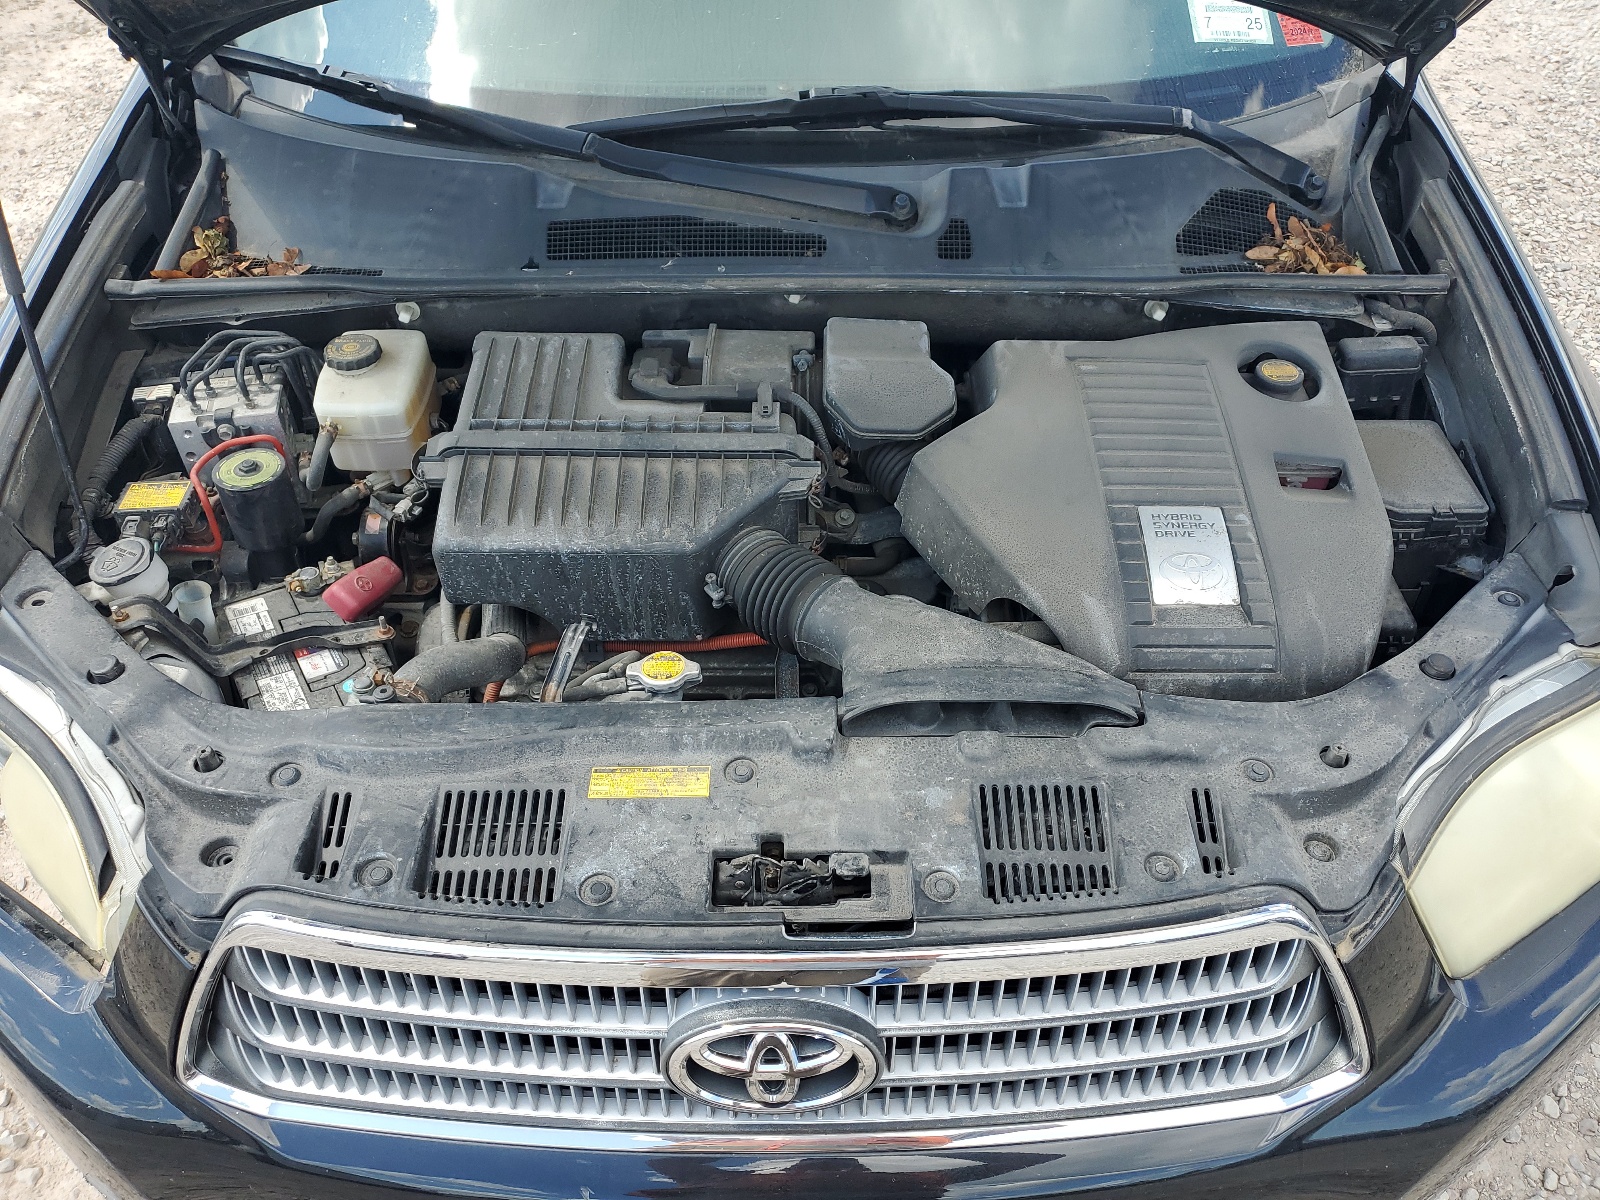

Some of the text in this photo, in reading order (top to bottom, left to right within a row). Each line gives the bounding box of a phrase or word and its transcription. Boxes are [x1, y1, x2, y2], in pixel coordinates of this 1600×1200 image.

[1203, 16, 1263, 31] 7 25
[1151, 513, 1203, 521] HYBRID
[1152, 521, 1216, 530] SYNERGY
[1154, 530, 1197, 538] DRIVE
